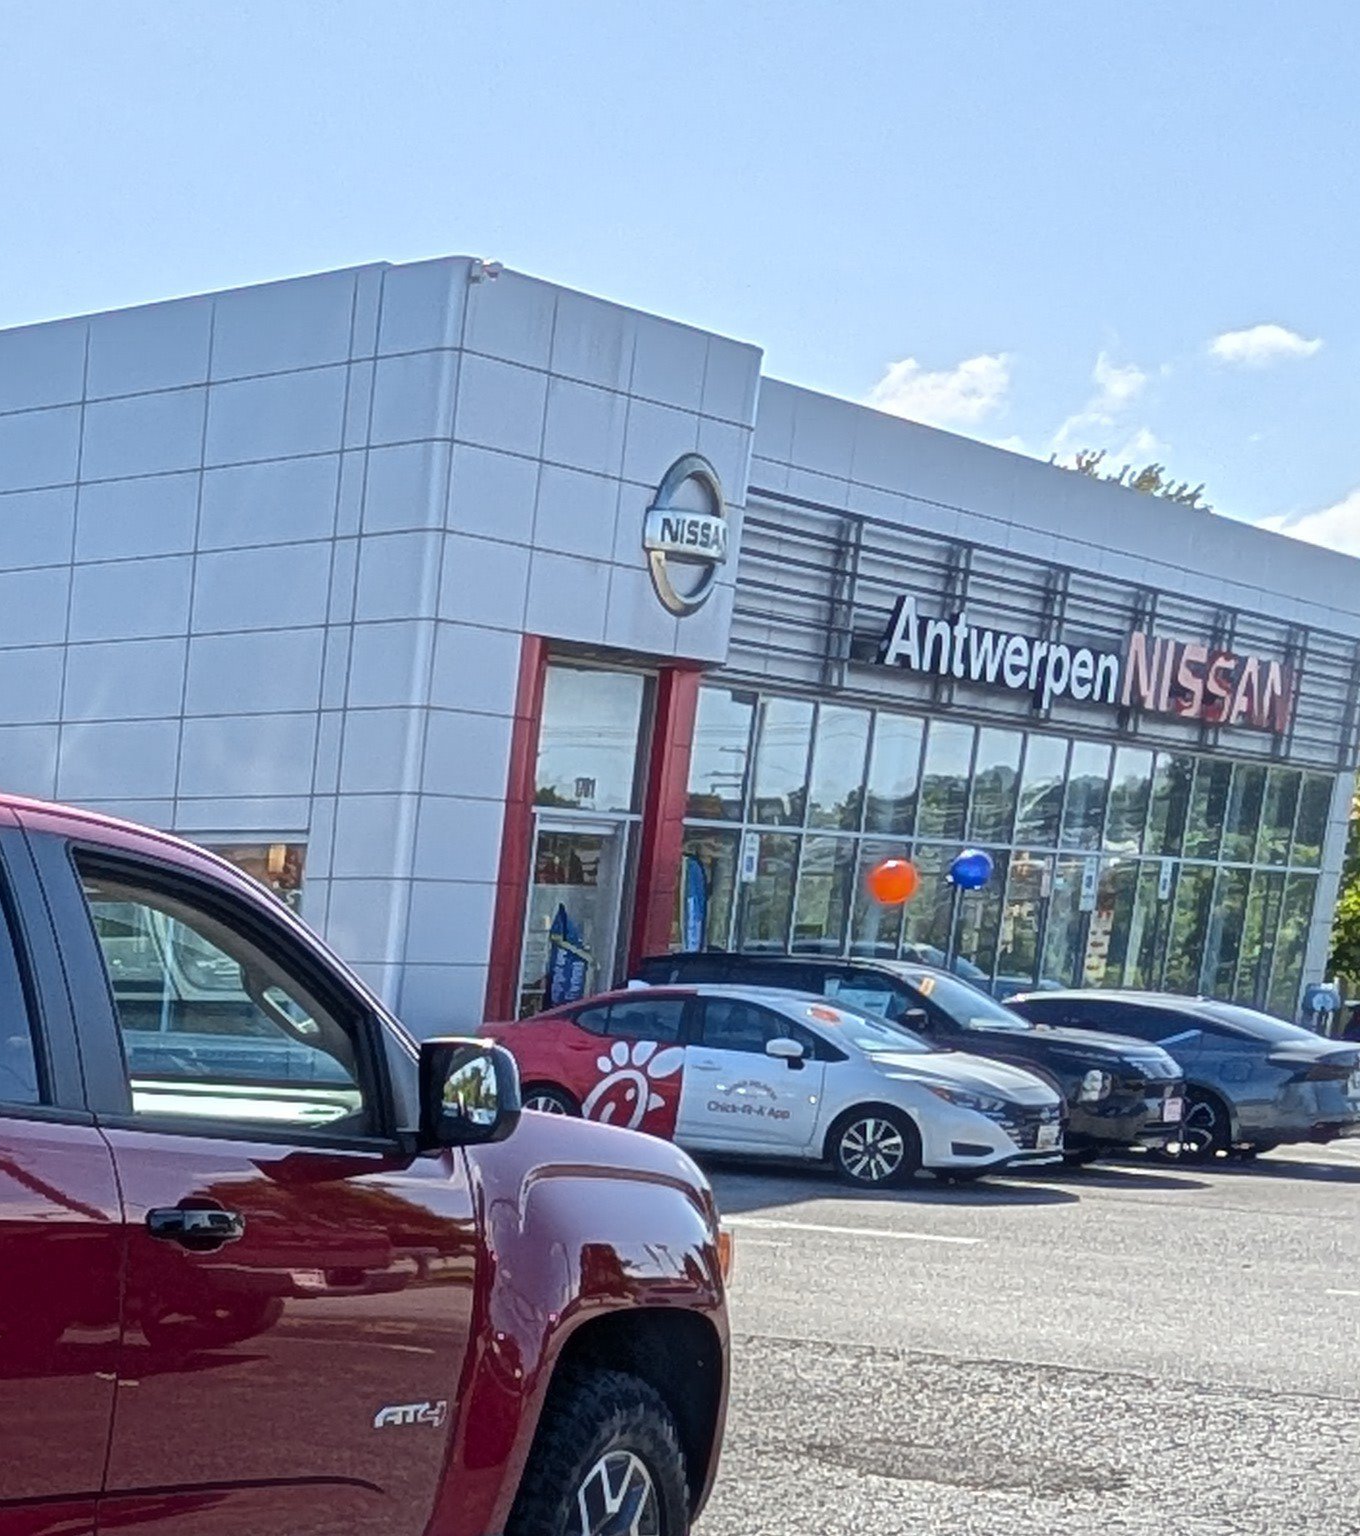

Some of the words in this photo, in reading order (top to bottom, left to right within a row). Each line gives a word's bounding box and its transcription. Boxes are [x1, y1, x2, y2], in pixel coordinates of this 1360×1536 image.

[885, 595, 1119, 709] Antwerpen
[1122, 631, 1298, 731] NISSAN
[374, 1400, 447, 1429] AT4
